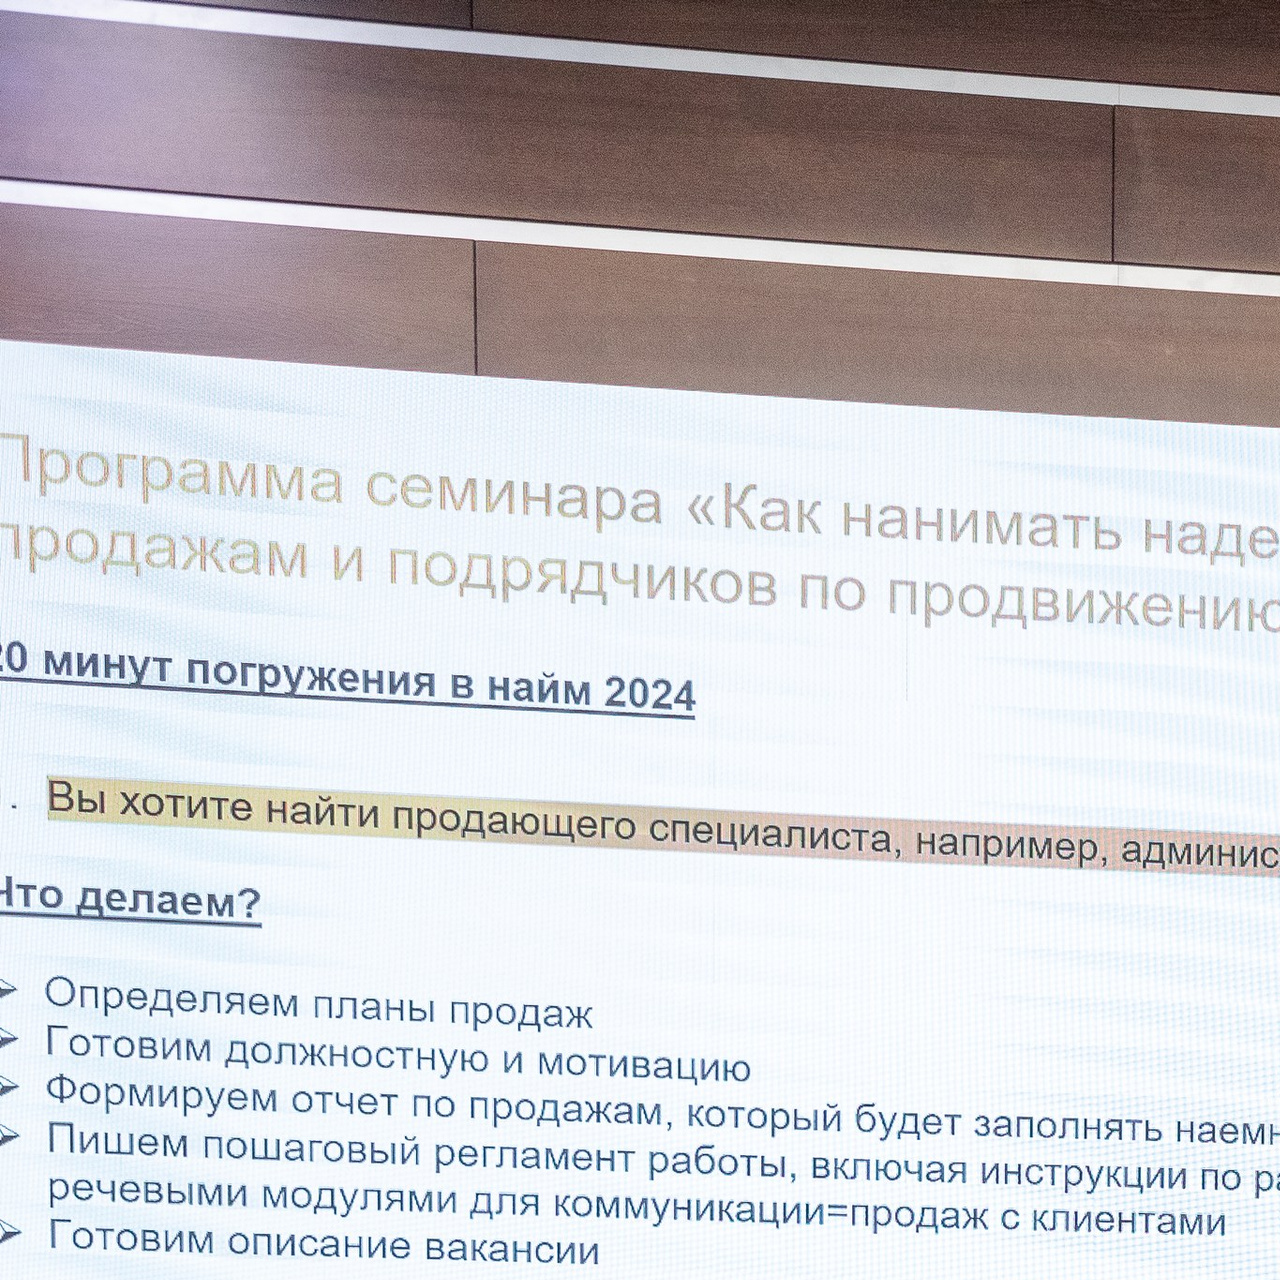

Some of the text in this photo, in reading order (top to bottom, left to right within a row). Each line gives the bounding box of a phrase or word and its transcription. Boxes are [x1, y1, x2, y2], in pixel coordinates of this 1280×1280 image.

[366, 471, 663, 534] семинара
[687, 481, 822, 535] «Как
[843, 501, 1123, 551] нанимать
[332, 544, 364, 583] и
[389, 548, 778, 607] подрядчиков
[800, 573, 867, 612] по
[0, 640, 697, 712] 0 минут погружения в найм 2024
[48, 779, 106, 815] Вы
[120, 791, 253, 822] хотите
[266, 795, 379, 829] найти
[393, 806, 637, 844] продающего
[649, 818, 902, 859] специалиста,
[916, 832, 1108, 869] например,
[75, 884, 261, 920] делаем?
[44, 974, 593, 1033] Определяем планы продаж
[46, 1023, 752, 1086] Готовим должностную и мотивацию
[45, 1072, 278, 1119] Формируем
[291, 1089, 399, 1117] отчет
[412, 1093, 456, 1119] по
[469, 1095, 673, 1131] продажам,
[687, 1103, 842, 1139] который
[854, 1102, 963, 1143] будет
[973, 1114, 1164, 1143] заполнять
[48, 1120, 189, 1158] Пишем
[203, 1134, 420, 1166] пошаговый
[434, 1143, 636, 1175] регламент
[648, 1143, 797, 1183] работы,
[811, 1156, 968, 1184] включая
[980, 1161, 1188, 1196] инструкции
[1200, 1167, 1242, 1192] по
[48, 1177, 1226, 1237] речевыми модулями для коммуникации=продаж с клиентами
[49, 1217, 599, 1266] Готовим описание вакансии
